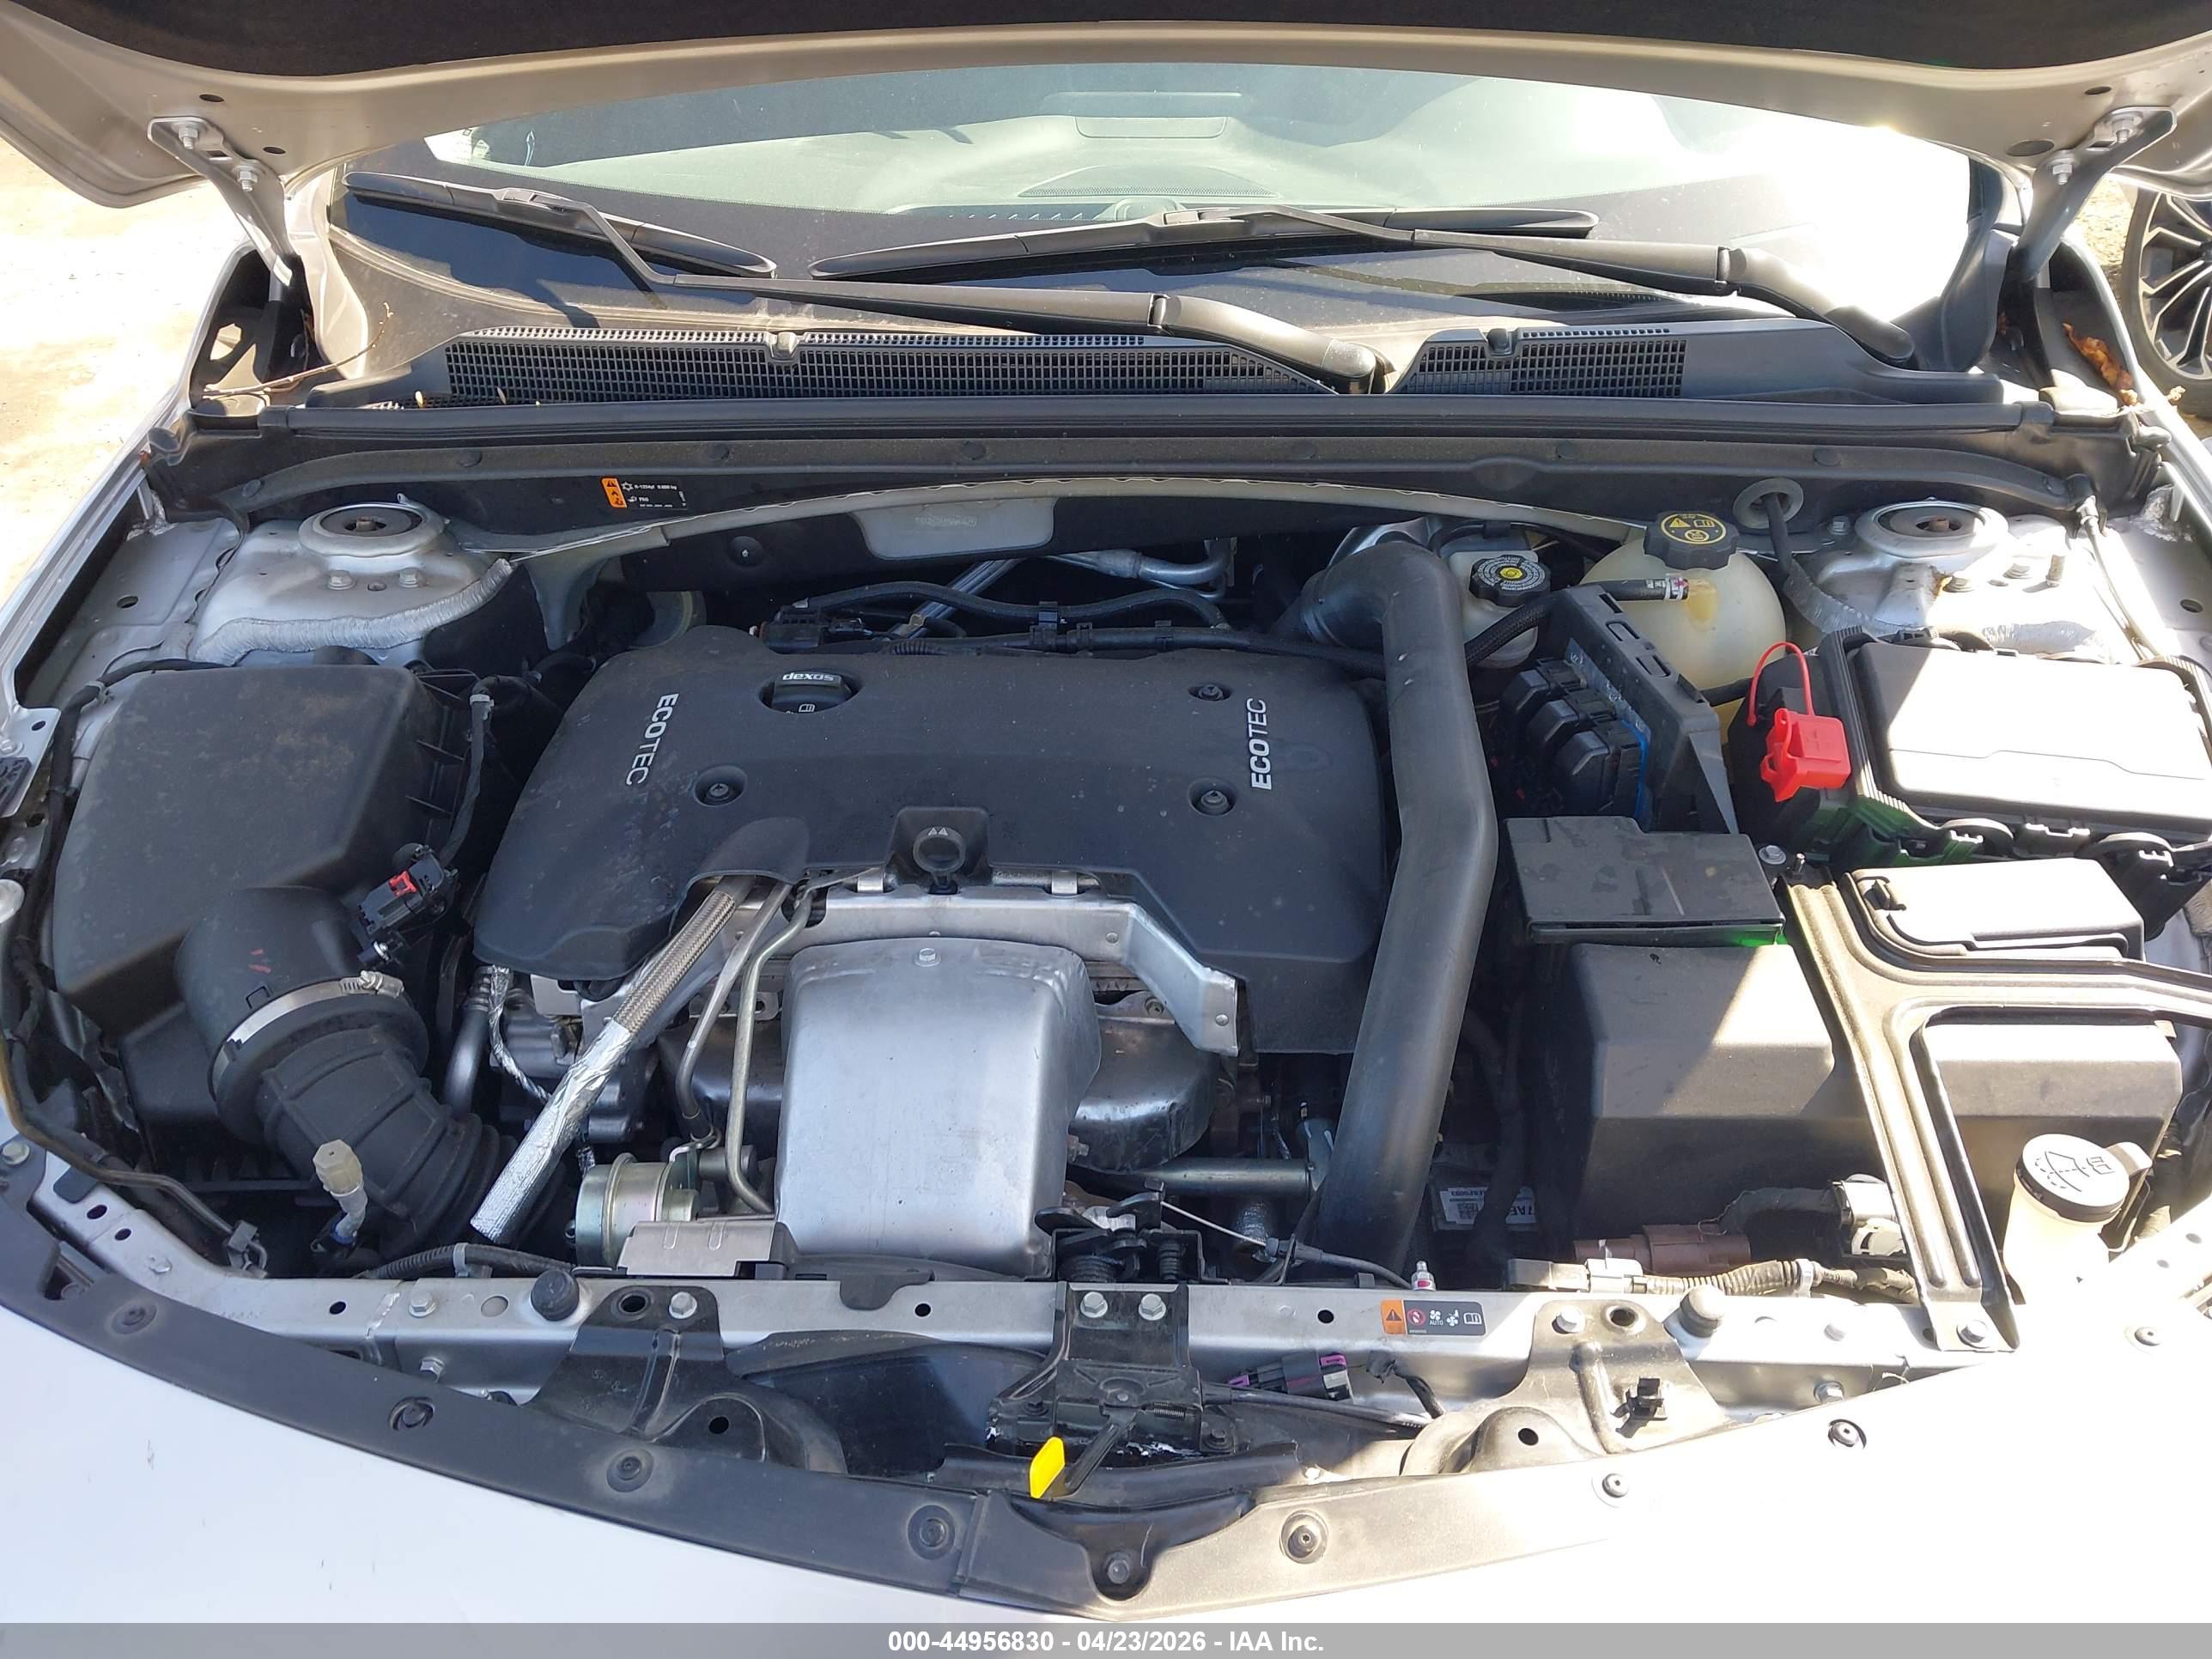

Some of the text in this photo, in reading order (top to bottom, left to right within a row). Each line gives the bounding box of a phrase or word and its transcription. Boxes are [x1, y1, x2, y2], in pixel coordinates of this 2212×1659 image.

[782, 672, 834, 681] dexos
[626, 693, 679, 786] ECOTEC
[1247, 698, 1272, 790] ECOTEC
